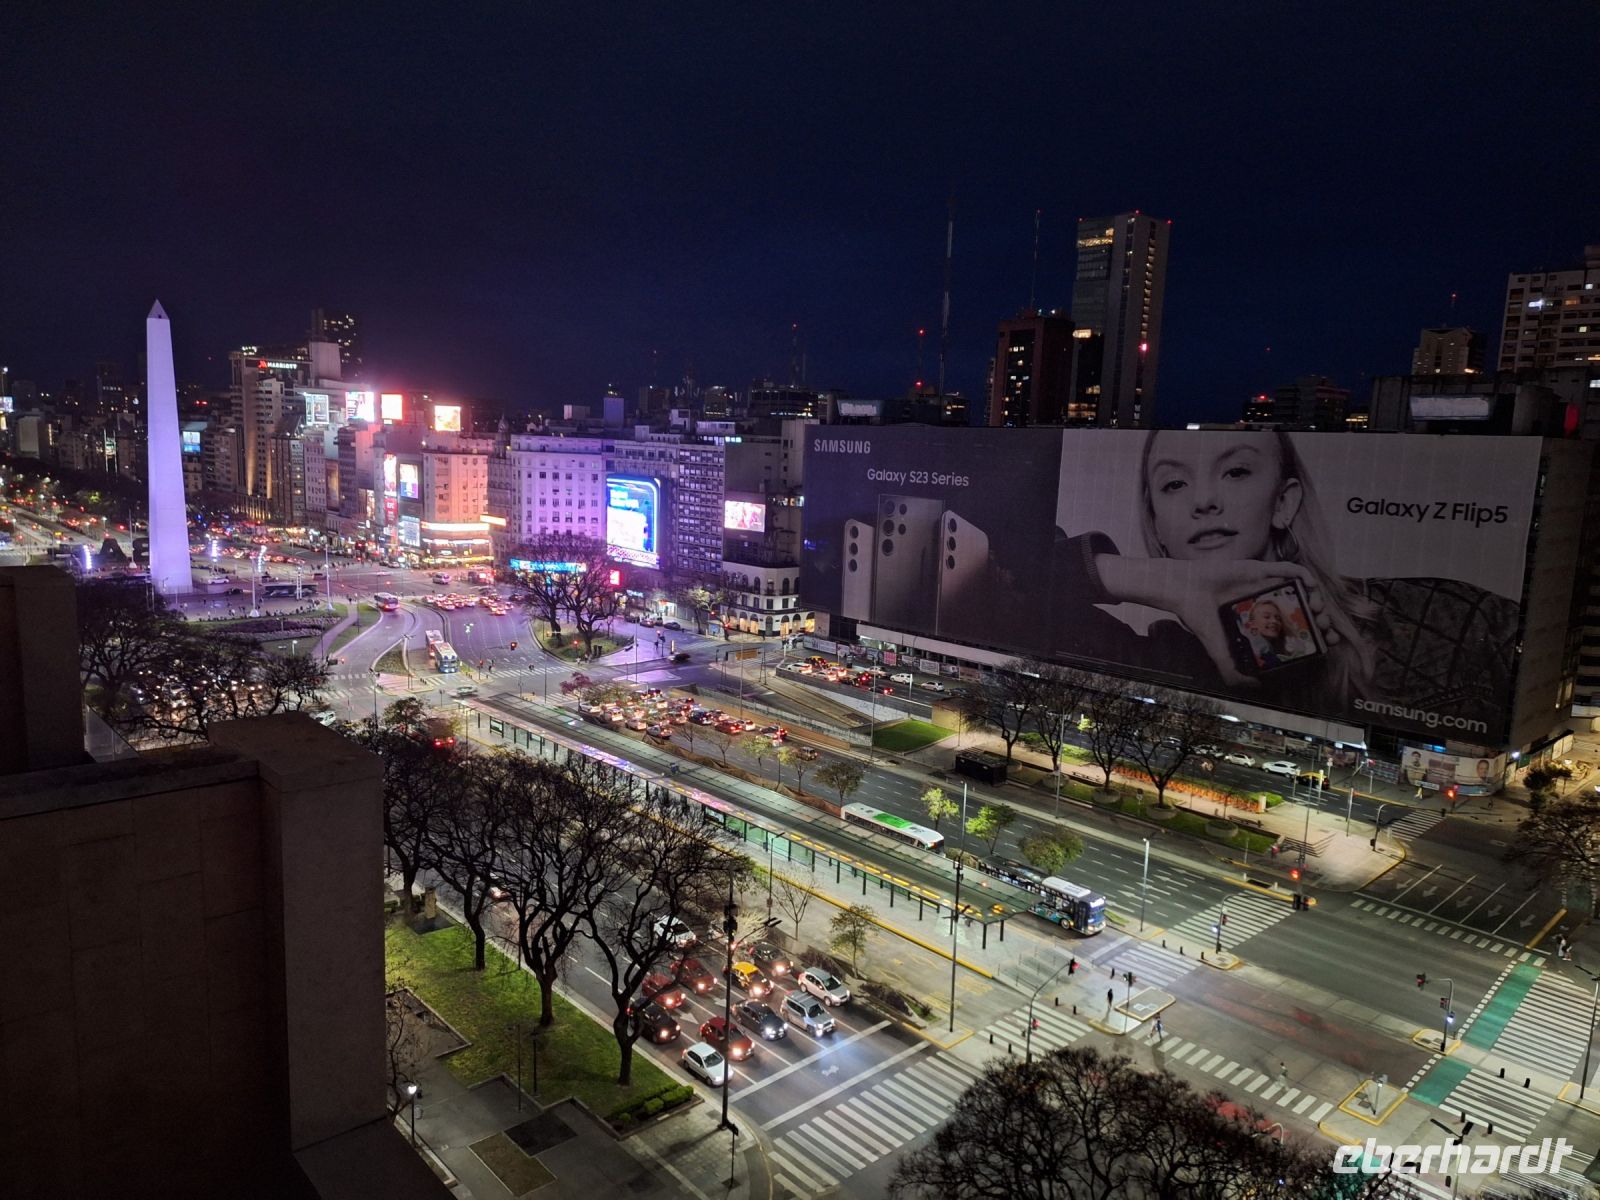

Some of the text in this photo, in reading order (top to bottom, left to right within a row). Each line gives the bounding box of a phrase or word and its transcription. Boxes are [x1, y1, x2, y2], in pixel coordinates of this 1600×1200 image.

[814, 438, 871, 454] SAMSUNG
[867, 468, 969, 487] Galaxy S23 Series
[1347, 497, 1509, 528] Galaxy Z Flip5
[1354, 698, 1487, 734] samsung.com
